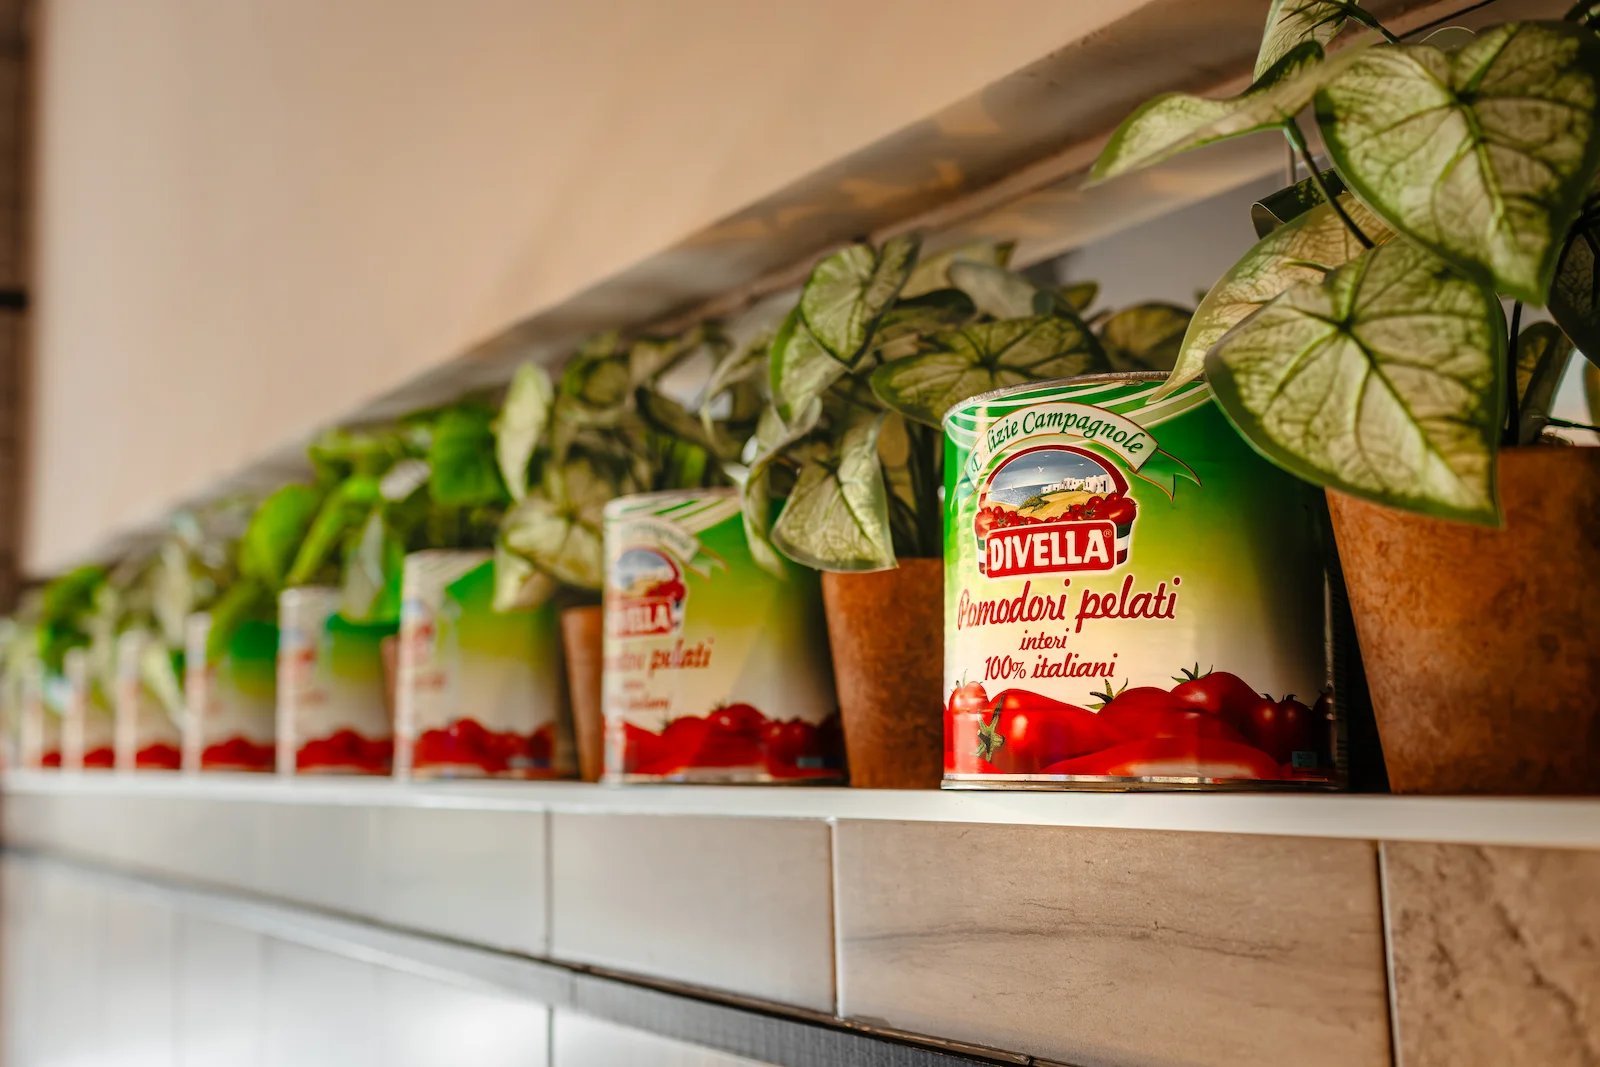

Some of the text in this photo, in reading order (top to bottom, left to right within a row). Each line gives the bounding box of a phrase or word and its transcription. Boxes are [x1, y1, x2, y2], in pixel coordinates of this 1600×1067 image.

[972, 411, 1146, 474] Dlizie Campagnole
[989, 529, 1110, 572] DIVELLA
[957, 574, 1181, 634] Pomodori pelati
[1018, 627, 1070, 651] interi
[984, 652, 1119, 681] 100% italiani
